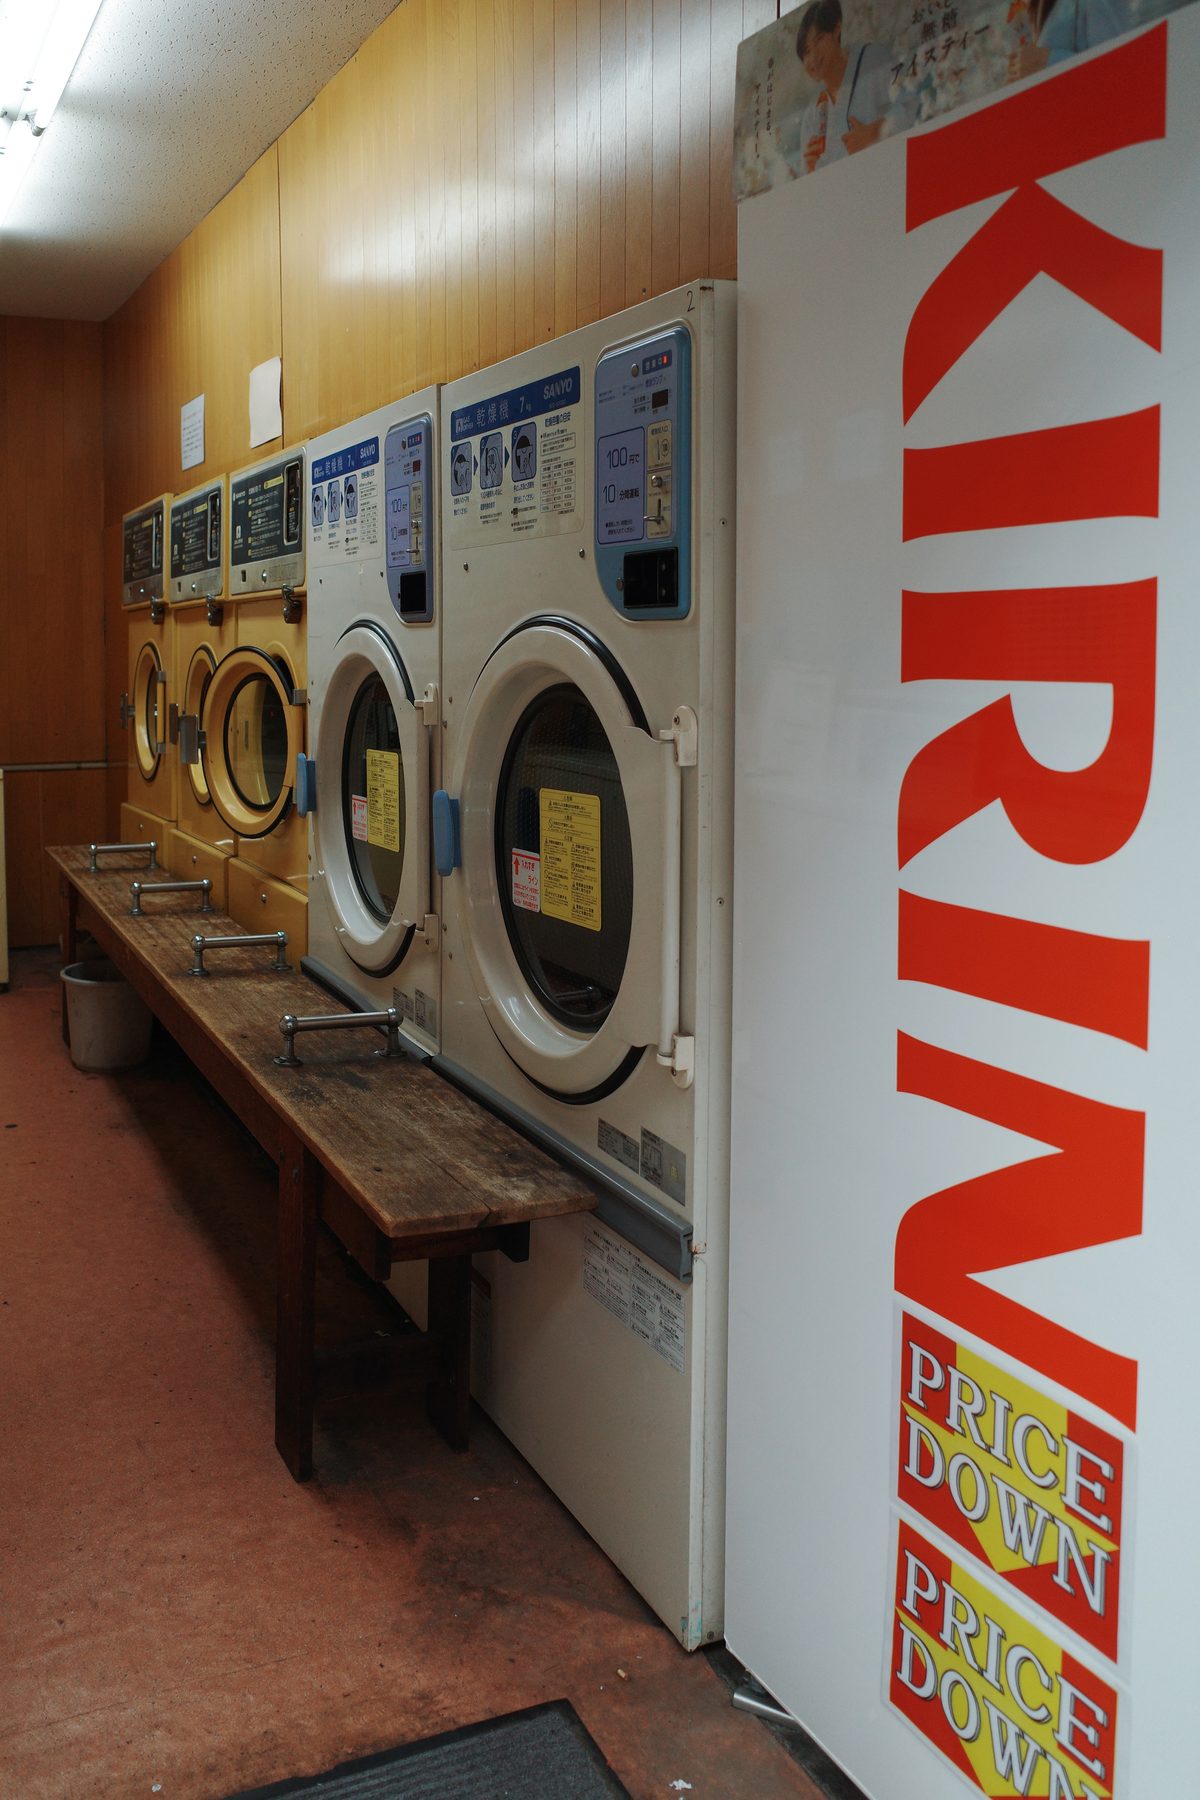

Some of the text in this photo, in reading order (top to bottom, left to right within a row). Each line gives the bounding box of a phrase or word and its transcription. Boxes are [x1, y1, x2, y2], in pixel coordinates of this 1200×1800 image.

[891, 24, 991, 85] アイスティー
[921, 8, 958, 43] 無糖
[475, 399, 510, 428] 乾燥機
[543, 377, 573, 400] SANYO
[602, 484, 616, 504] 10
[894, 20, 1167, 1433] KIRIN
[907, 1340, 1114, 1535] PRICE
[902, 1413, 1112, 1618] DOWN
[902, 1547, 1108, 1784] PRICE
